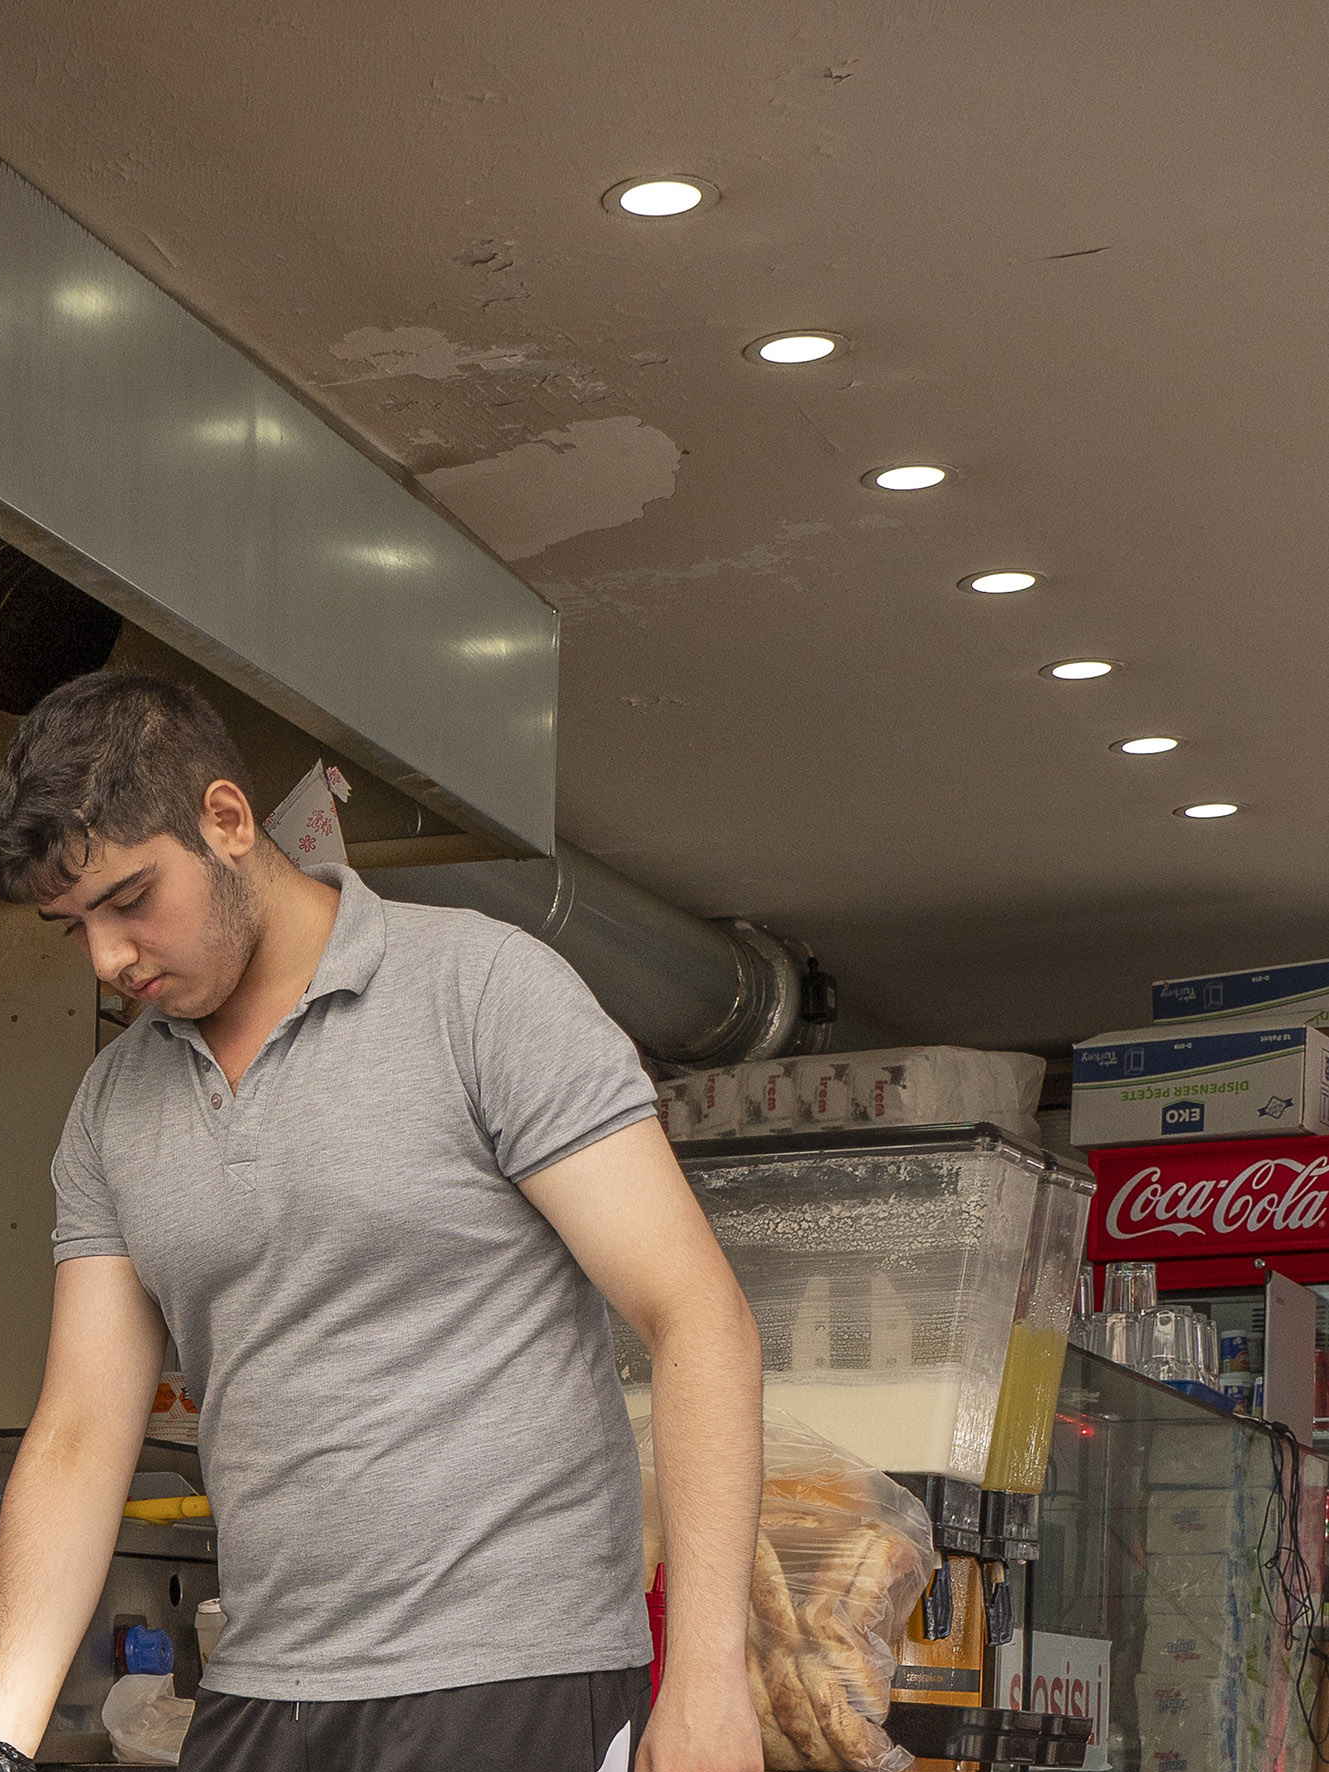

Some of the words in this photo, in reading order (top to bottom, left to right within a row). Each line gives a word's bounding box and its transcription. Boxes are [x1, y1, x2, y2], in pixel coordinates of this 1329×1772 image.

[1260, 1034, 1282, 1043] Paket
[1081, 1050, 1117, 1063] Turkey
[767, 1074, 782, 1112] irem
[818, 1076, 833, 1114] irem
[1121, 1086, 1170, 1101] PEÇETE
[1174, 1080, 1250, 1097] DİSPENSER
[874, 1080, 889, 1117] irem
[1165, 1107, 1201, 1124] EKO
[1105, 1155, 1329, 1240] Coca-Cola
